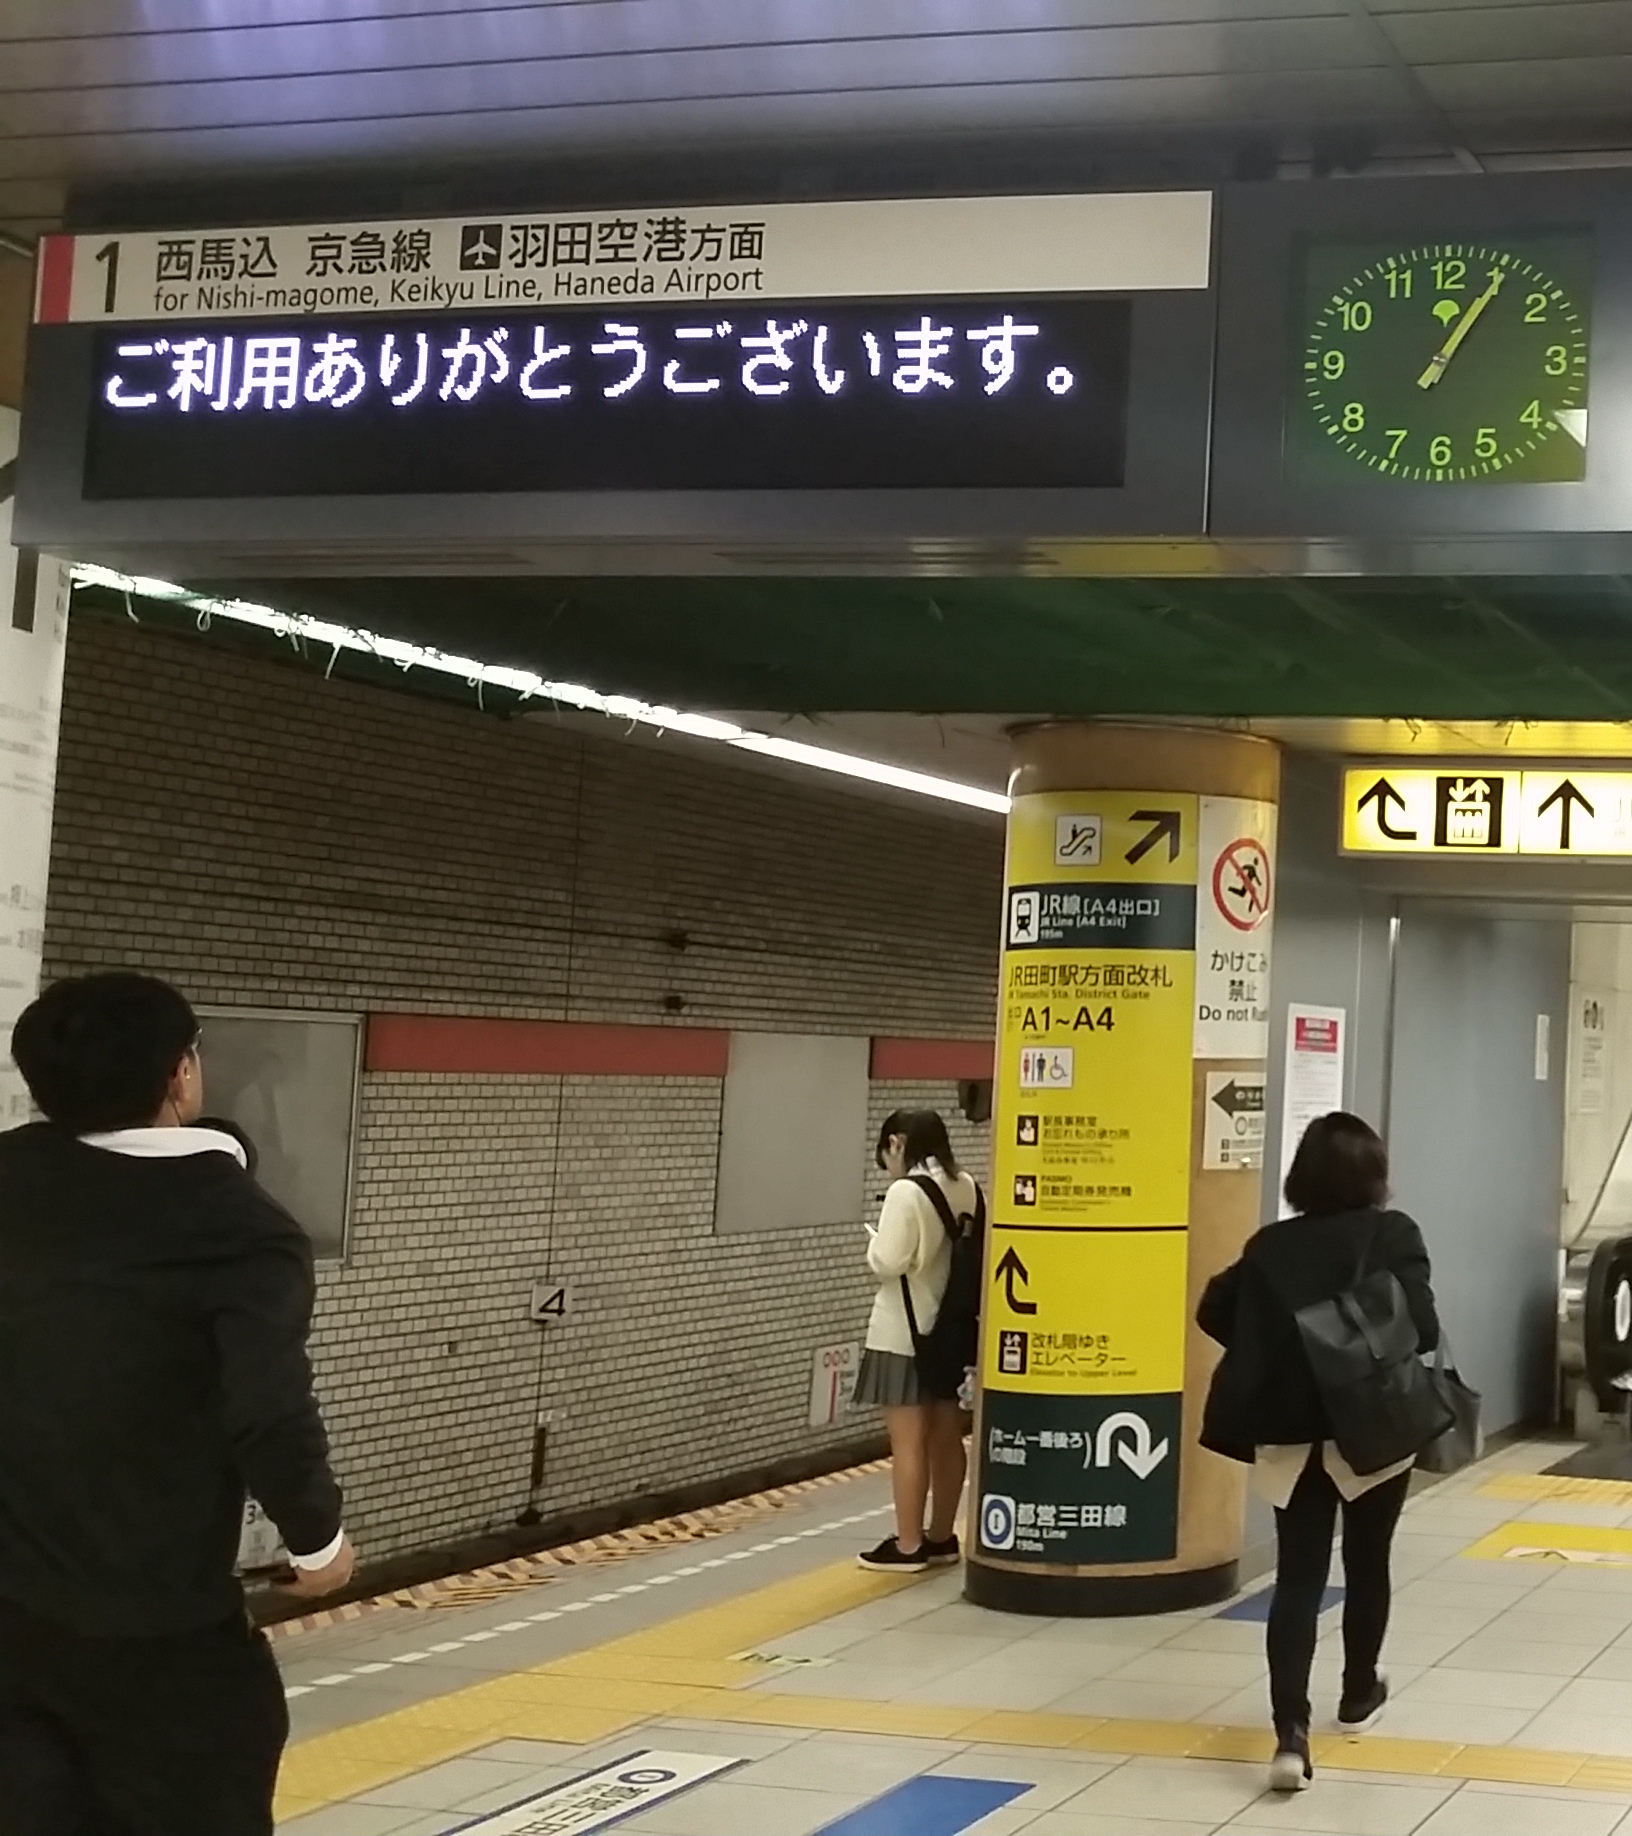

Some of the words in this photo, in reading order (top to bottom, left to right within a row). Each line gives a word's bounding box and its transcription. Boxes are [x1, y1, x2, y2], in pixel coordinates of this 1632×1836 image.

[156, 239, 278, 283] 西馬込
[306, 231, 432, 277] 京急線
[508, 217, 766, 268] 羽田空港方面
[97, 242, 121, 312] 1
[154, 286, 190, 312] for
[197, 284, 380, 312] Nishi-magome,
[390, 276, 474, 308] Keikyu
[483, 273, 543, 302] Line,
[554, 269, 654, 297] Haneda
[664, 267, 764, 299] Airport
[1385, 269, 1413, 298] 11
[1431, 261, 1466, 290] 12
[1337, 301, 1372, 331] 10
[1523, 293, 1548, 323] 2
[106, 314, 1074, 412] ご利用ありがとうございます。
[1323, 350, 1345, 380] 9
[1545, 345, 1567, 375] 3
[1342, 403, 1365, 432] 8
[1519, 399, 1542, 428] 4
[1385, 429, 1408, 459] 7
[1430, 436, 1451, 466] 6
[1475, 428, 1497, 457] 5
[1009, 964, 1174, 988] JR田町駅方面改札
[1075, 989, 1118, 999] District
[1122, 989, 1150, 1000] Gate
[1199, 1005, 1222, 1021] Do
[1226, 1008, 1249, 1021] not
[539, 1288, 566, 1317] 4
[1031, 1351, 1127, 1368] エレベーター
